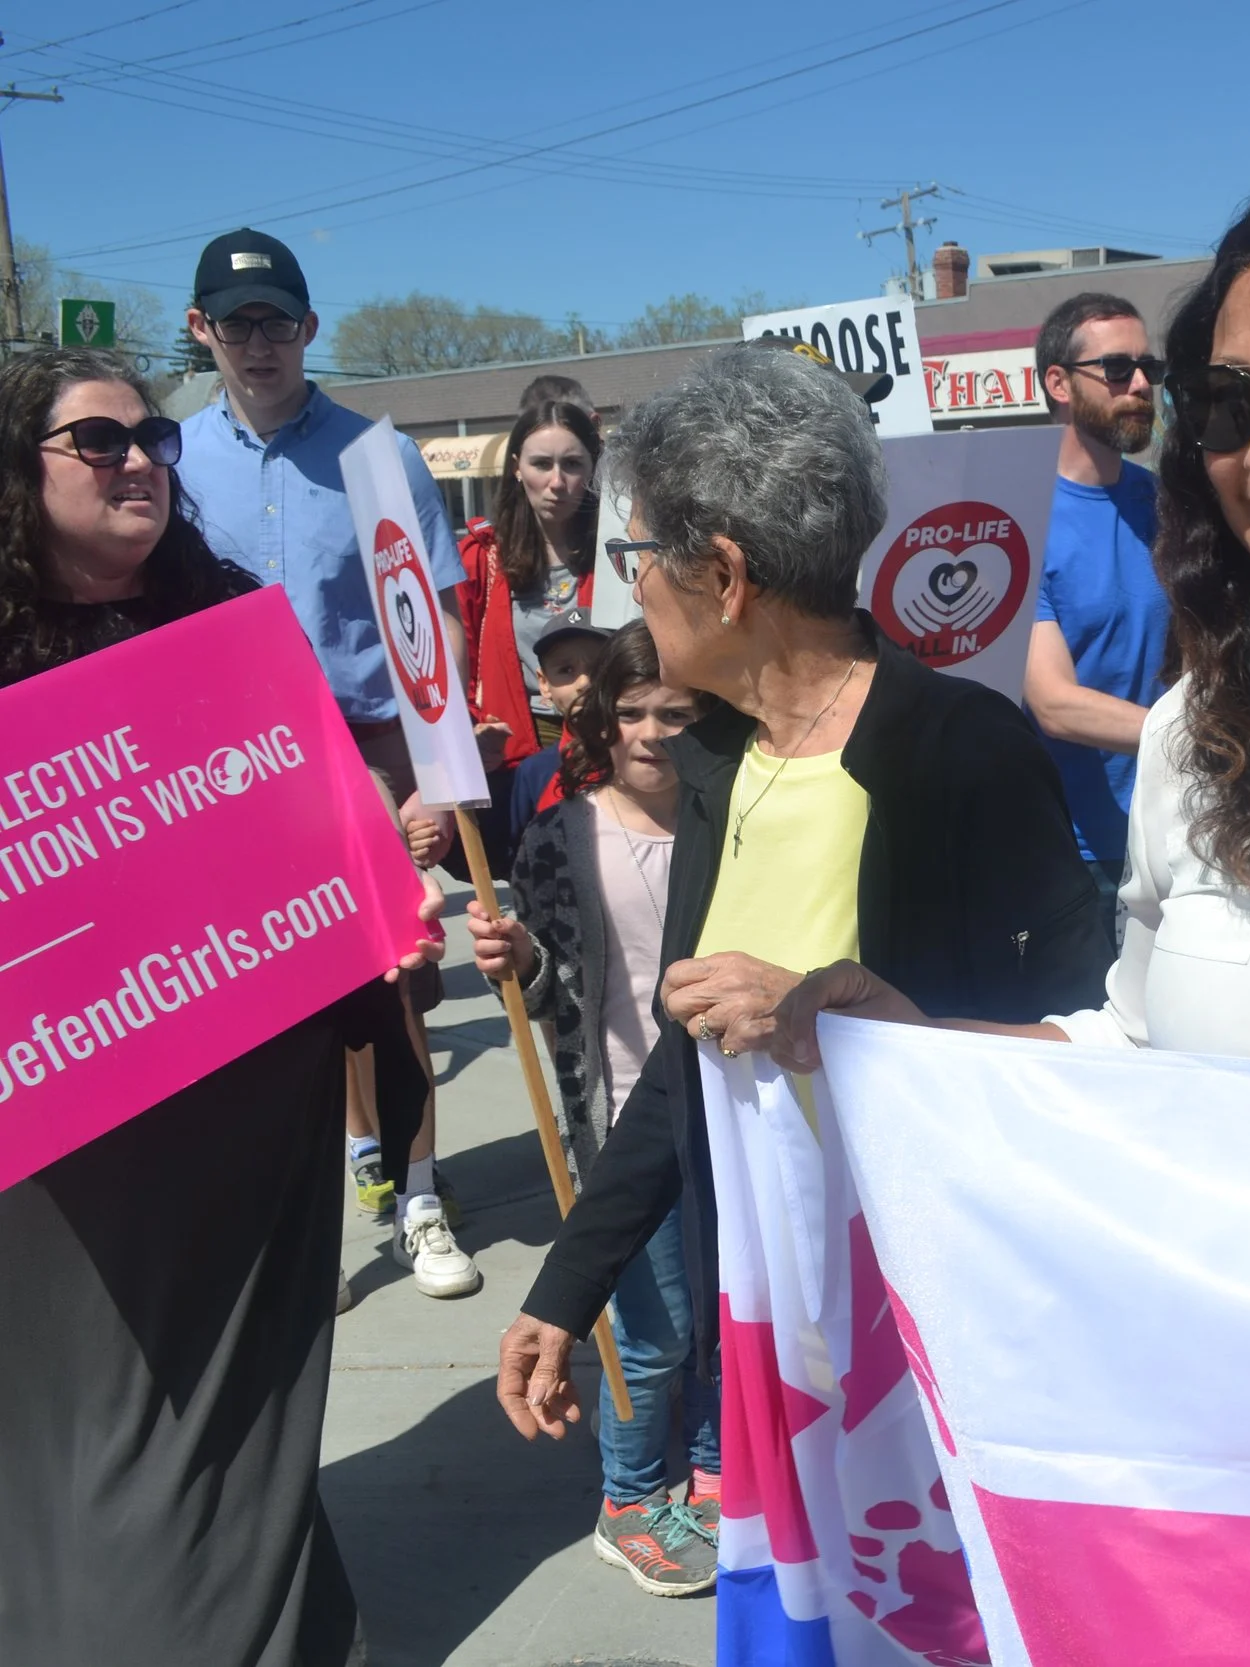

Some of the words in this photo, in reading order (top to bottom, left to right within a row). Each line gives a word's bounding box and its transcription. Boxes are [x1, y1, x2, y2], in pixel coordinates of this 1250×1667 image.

[762, 310, 911, 376] OOSE
[905, 519, 1011, 549] PRO-LIFE
[374, 536, 414, 577] PRO-LIFE
[952, 634, 982, 656] IN.
[427, 683, 446, 709] IN.
[0, 724, 151, 832] LECTIVE
[0, 816, 99, 902] TION
[95, 796, 146, 850] IS
[141, 724, 306, 826] WRONG
